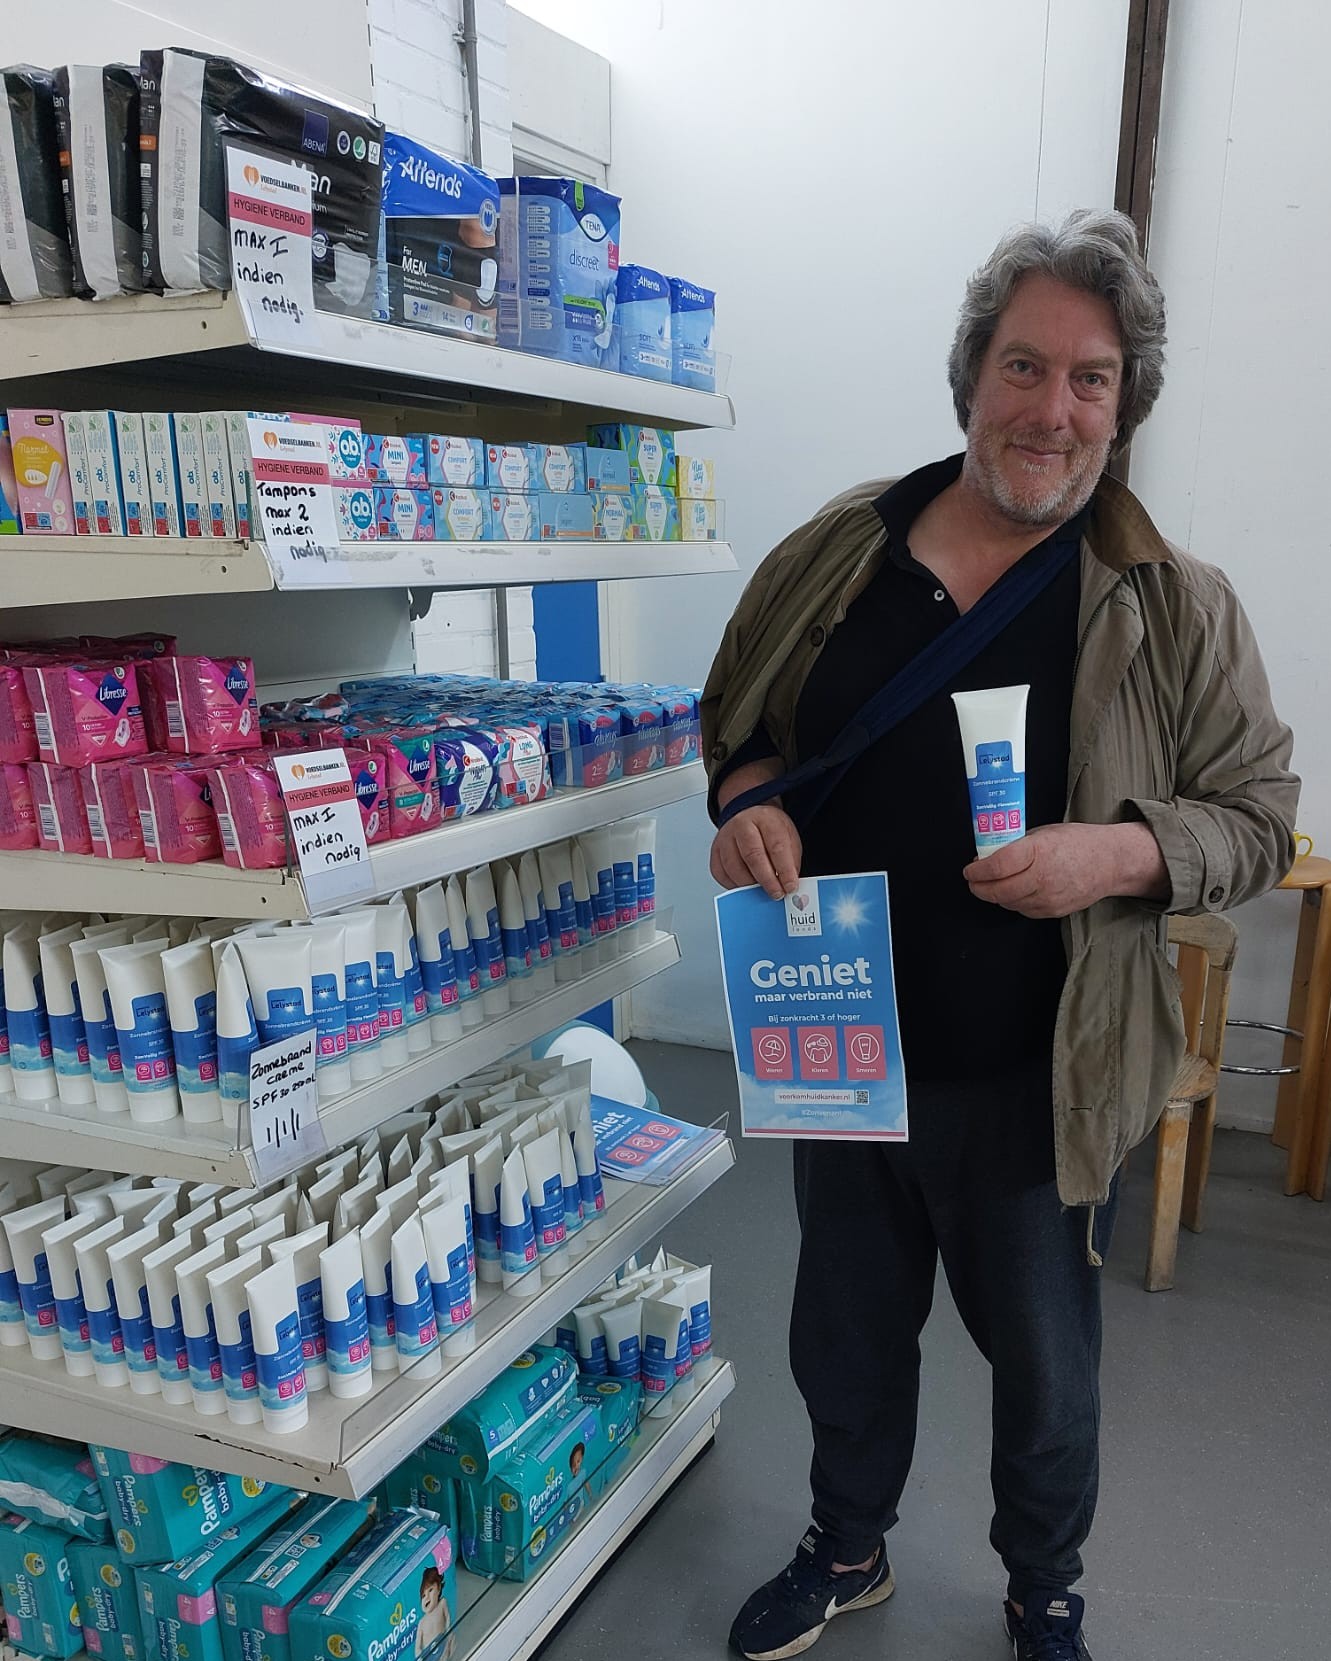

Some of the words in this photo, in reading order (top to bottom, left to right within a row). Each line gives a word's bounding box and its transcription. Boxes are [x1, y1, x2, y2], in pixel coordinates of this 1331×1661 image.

[303, 138, 325, 153] ABENA
[400, 156, 462, 199] Attends
[233, 197, 269, 216] HYGIENE
[269, 207, 306, 226] VERBAND
[585, 220, 602, 233] TENA
[403, 245, 413, 256] For
[402, 255, 428, 277] MEN
[570, 249, 599, 271] discreet
[237, 262, 284, 285] indien
[636, 275, 661, 292] Attends
[680, 287, 706, 304] Attends
[387, 449, 404, 461] MINI
[257, 462, 291, 474] HYGIENE
[291, 465, 324, 476] VERBAND
[256, 482, 317, 501] Tampons
[298, 504, 309, 521] 2
[271, 524, 313, 536] indien
[227, 676, 249, 690] Libresse
[100, 686, 127, 701] Libresse
[409, 759, 431, 774] Libresse
[289, 790, 319, 802] HYGIENE
[319, 784, 350, 797] VERBAND
[354, 782, 378, 796] Libresse
[300, 831, 344, 855] indien
[325, 844, 361, 864] nodig
[790, 911, 816, 926] huid
[750, 954, 872, 988] Geniet
[755, 992, 785, 1003] maar
[789, 989, 844, 1002] verbrand
[847, 988, 872, 1000] niet
[768, 1014, 779, 1024] Bij
[780, 1013, 819, 1022] zonkracht
[837, 1013, 861, 1022] hoger
[252, 1089, 278, 1110] SPF
[779, 1093, 851, 1101] voorkomhuidkanker.nl
[593, 1112, 626, 1138] niet
[489, 1430, 496, 1439] 5
[115, 1480, 130, 1521] baby-dry
[123, 1474, 141, 1527] Pampers
[530, 1472, 564, 1515] Pampers
[533, 1491, 561, 1523] baby-dry
[480, 1505, 493, 1542] Pampers
[16, 1574, 32, 1618] Pampers
[1049, 1600, 1068, 1609] NIKE
[92, 1587, 110, 1632] Pampers
[104, 1593, 117, 1629] baby-dry
[368, 1607, 418, 1661] Pampers
